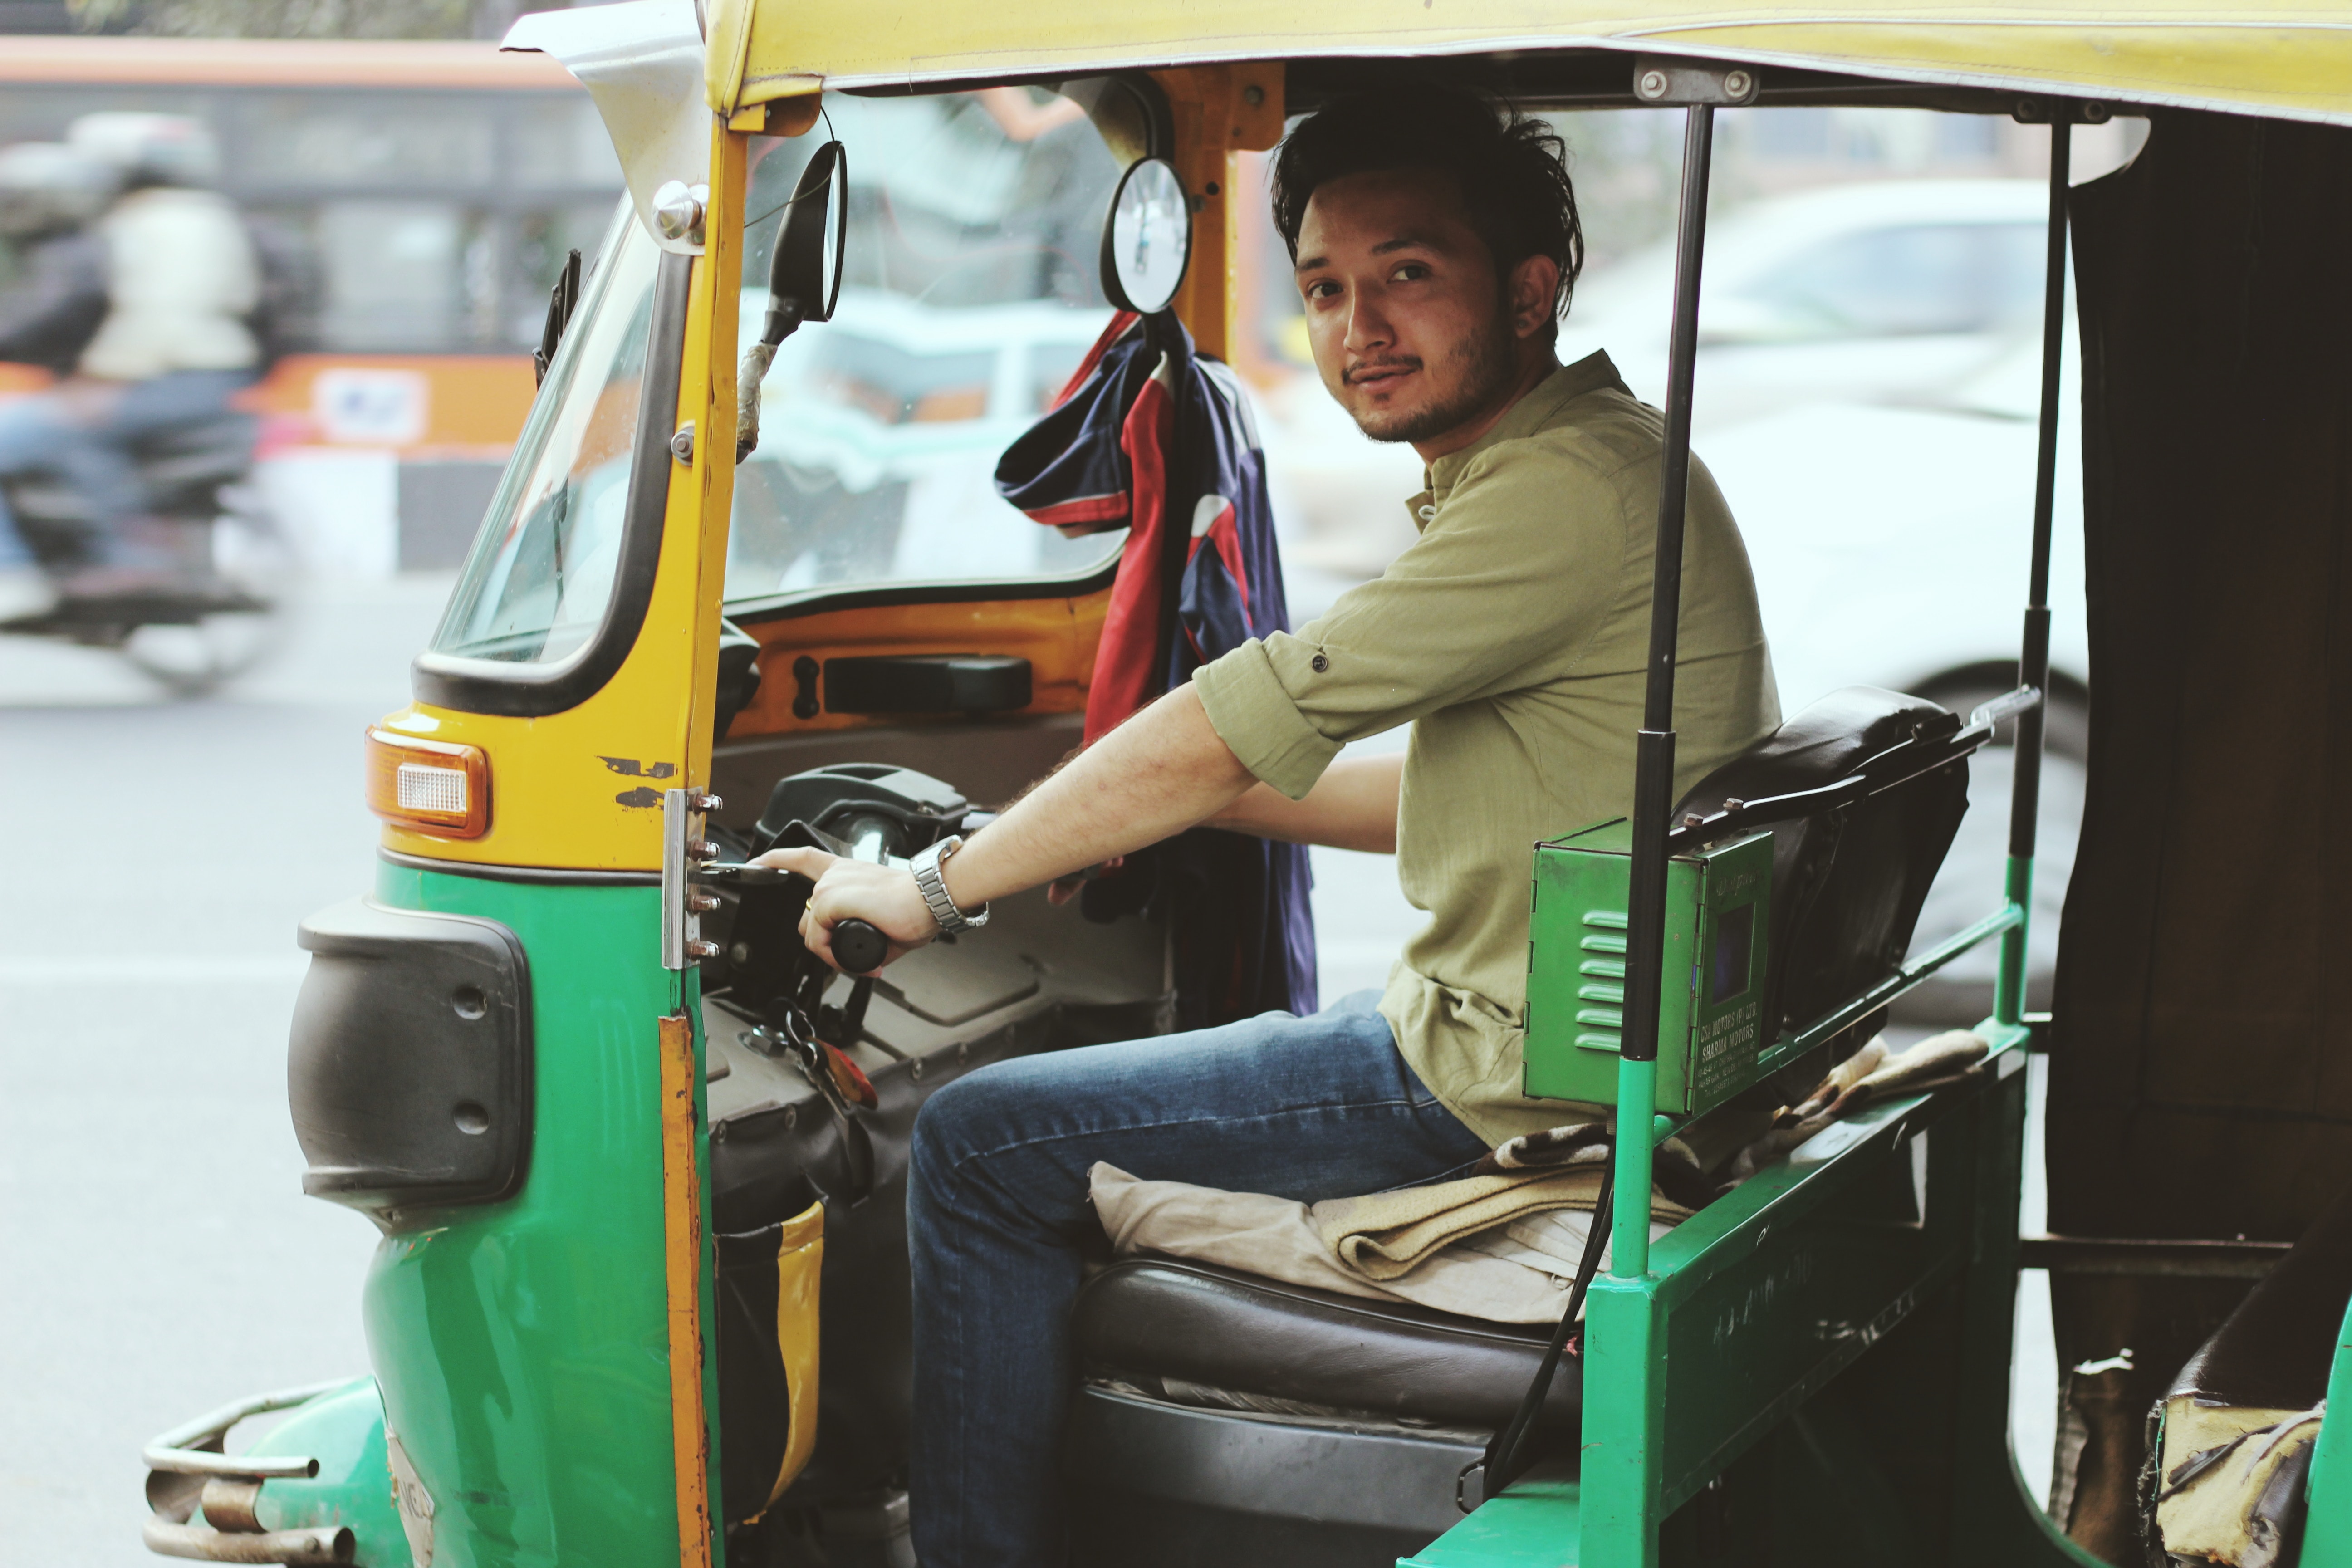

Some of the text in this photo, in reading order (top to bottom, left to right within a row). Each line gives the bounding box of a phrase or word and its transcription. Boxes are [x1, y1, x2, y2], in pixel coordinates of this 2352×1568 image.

[1712, 1010, 1735, 1037] MOTORS
[1736, 1007, 1745, 1027] (P)
[1746, 1001, 1758, 1020] LTD.
[1702, 1036, 1727, 1063] SHARMA
[1729, 1022, 1754, 1048] MOTORS
